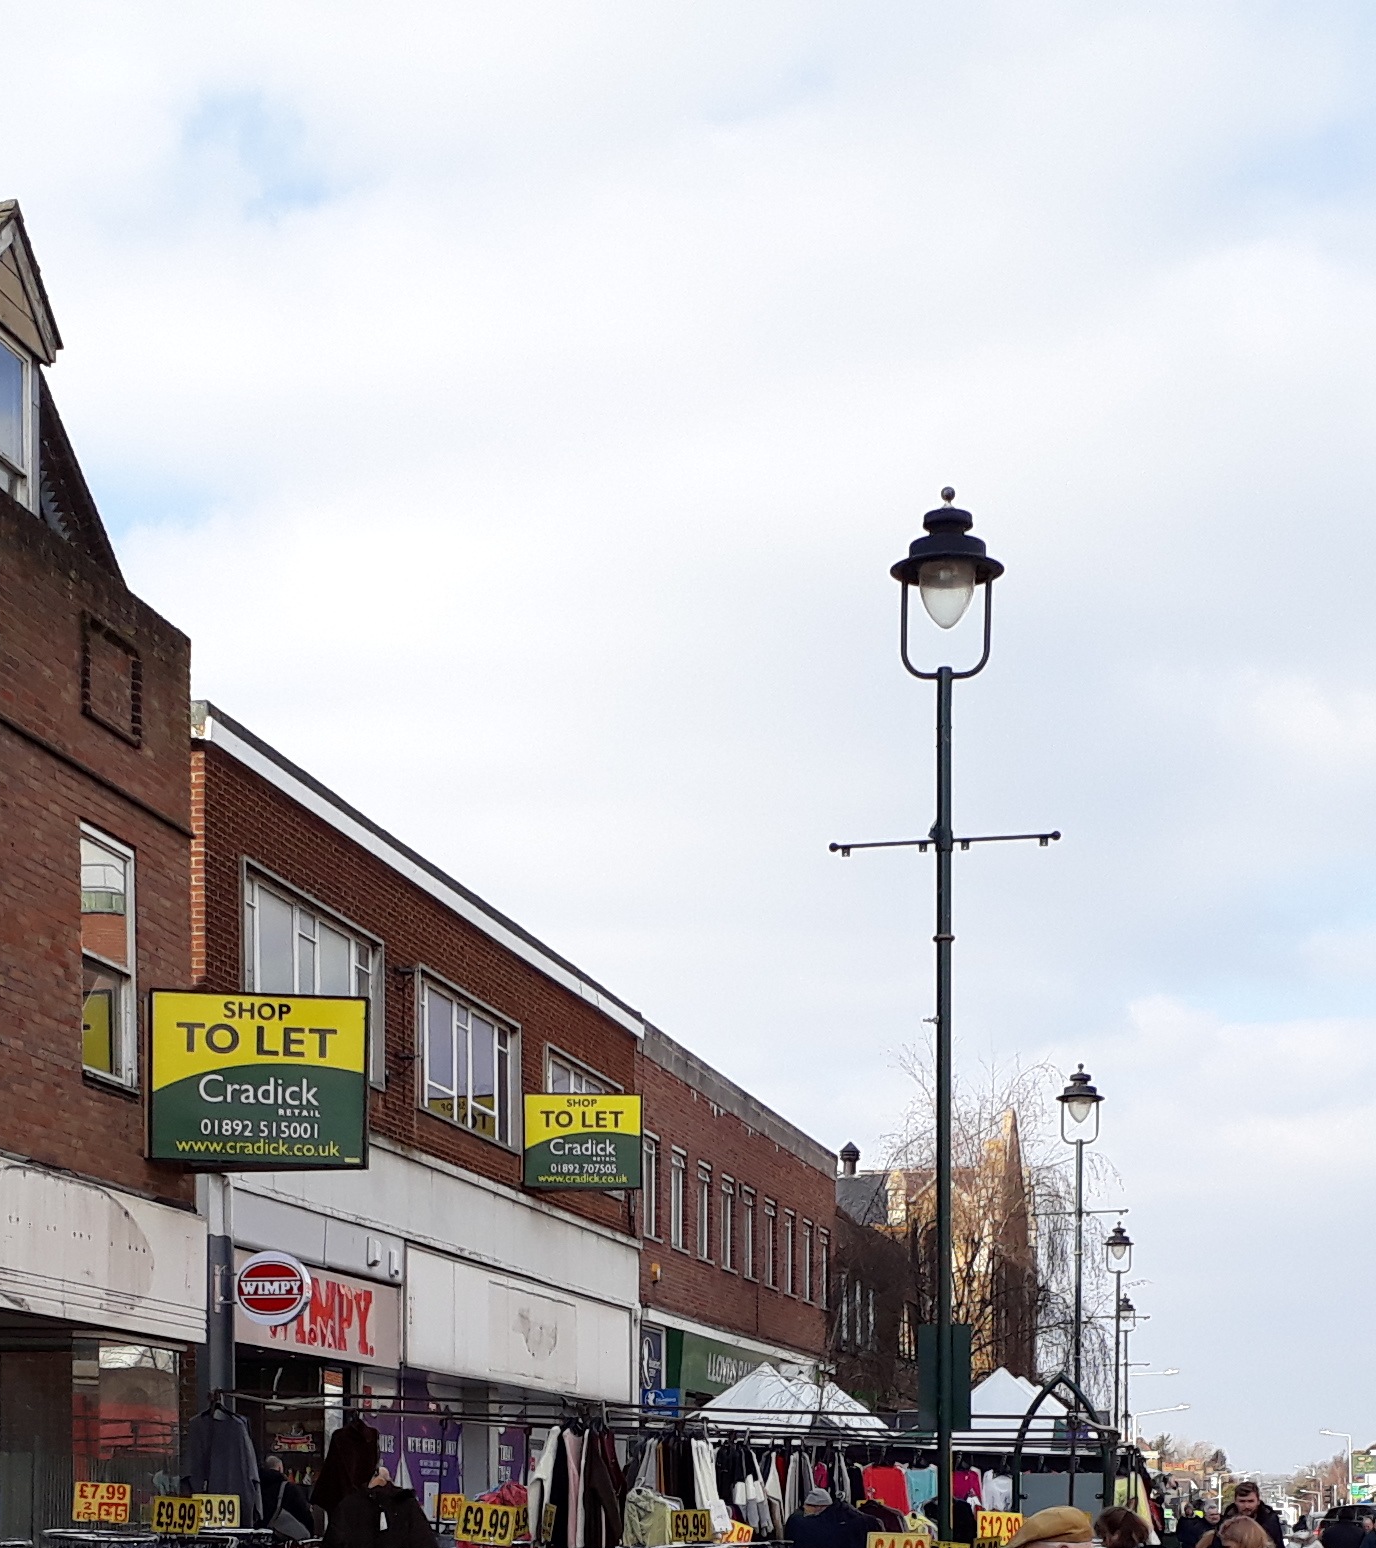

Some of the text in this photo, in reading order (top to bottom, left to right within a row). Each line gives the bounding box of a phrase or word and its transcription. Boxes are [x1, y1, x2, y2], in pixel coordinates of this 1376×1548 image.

[223, 1000, 292, 1021] SHOP
[176, 1021, 338, 1058] TO LET
[198, 1073, 320, 1107] Cradick
[566, 1098, 598, 1108] SHOP
[278, 1108, 322, 1118] RETAIL
[540, 1110, 624, 1129] TO LET
[200, 1118, 320, 1139] 01892 515001
[176, 1138, 341, 1158] www.cradick.co.uk
[549, 1138, 617, 1156] Cradick
[550, 1163, 580, 1174] 01892
[537, 1173, 628, 1185] www.cradick.co.uk
[240, 1281, 302, 1296] WIMPY
[79, 1484, 127, 1501] £7.99
[83, 1501, 92, 1510] 2
[156, 1500, 196, 1530] £9.99
[461, 1505, 510, 1540] £9.99
[675, 1512, 708, 1539] £9.99
[980, 1516, 1021, 1546] £12.99
